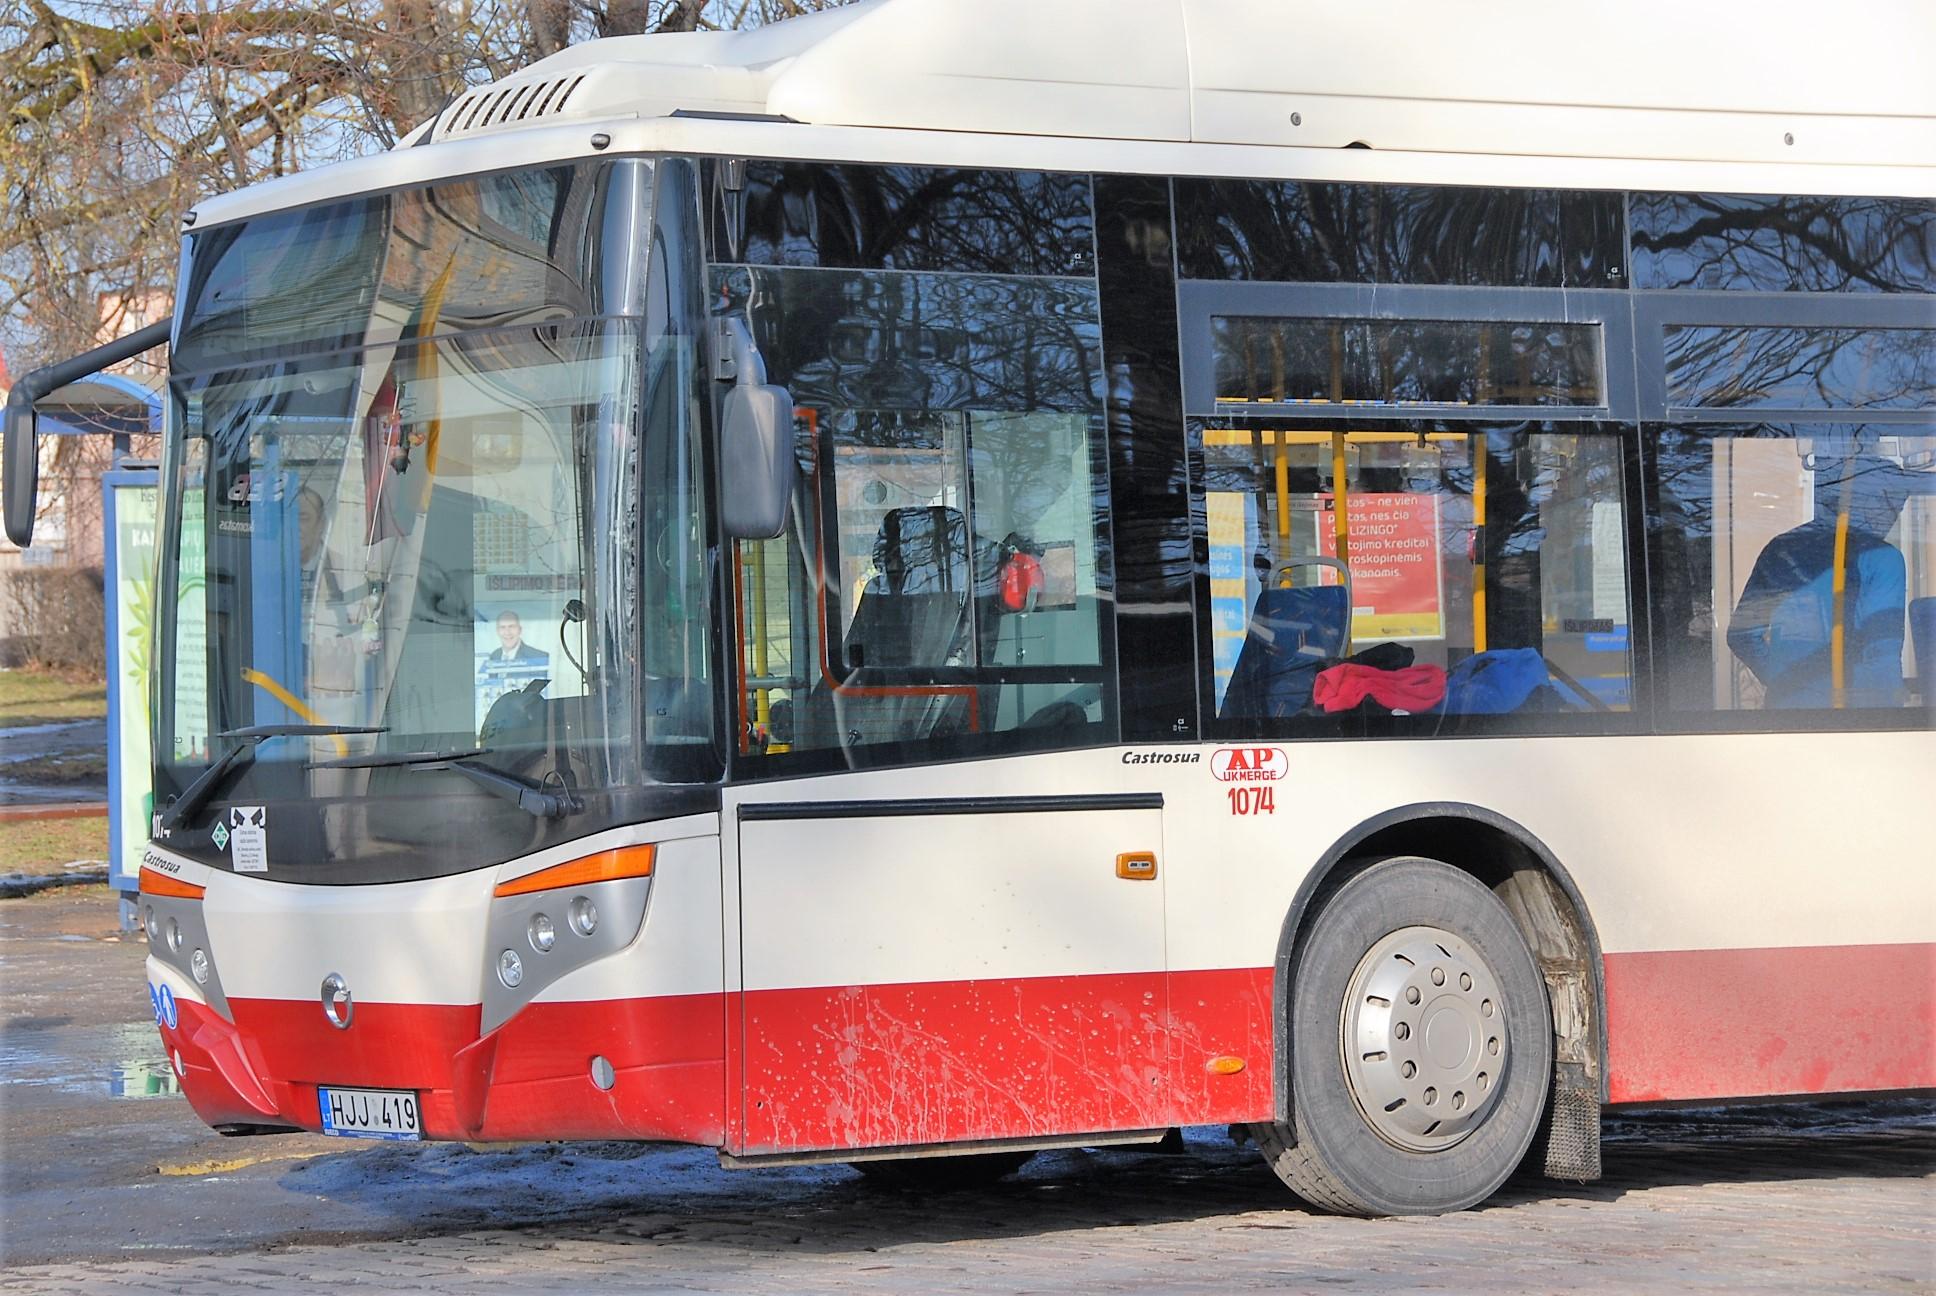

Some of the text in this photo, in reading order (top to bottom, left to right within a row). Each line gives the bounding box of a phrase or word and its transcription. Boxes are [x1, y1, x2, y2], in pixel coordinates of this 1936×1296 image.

[1394, 496, 1418, 506] vien
[1370, 512, 1390, 521] nes
[1328, 538, 1429, 552] vtojimo kreditai
[1348, 552, 1423, 566] roskopinėmis
[1121, 751, 1200, 764] Castrosua
[1226, 748, 1273, 771] AP
[1228, 786, 1275, 816] 1074
[143, 850, 181, 874] Castrosua
[330, 1094, 415, 1129] HJJ 419
